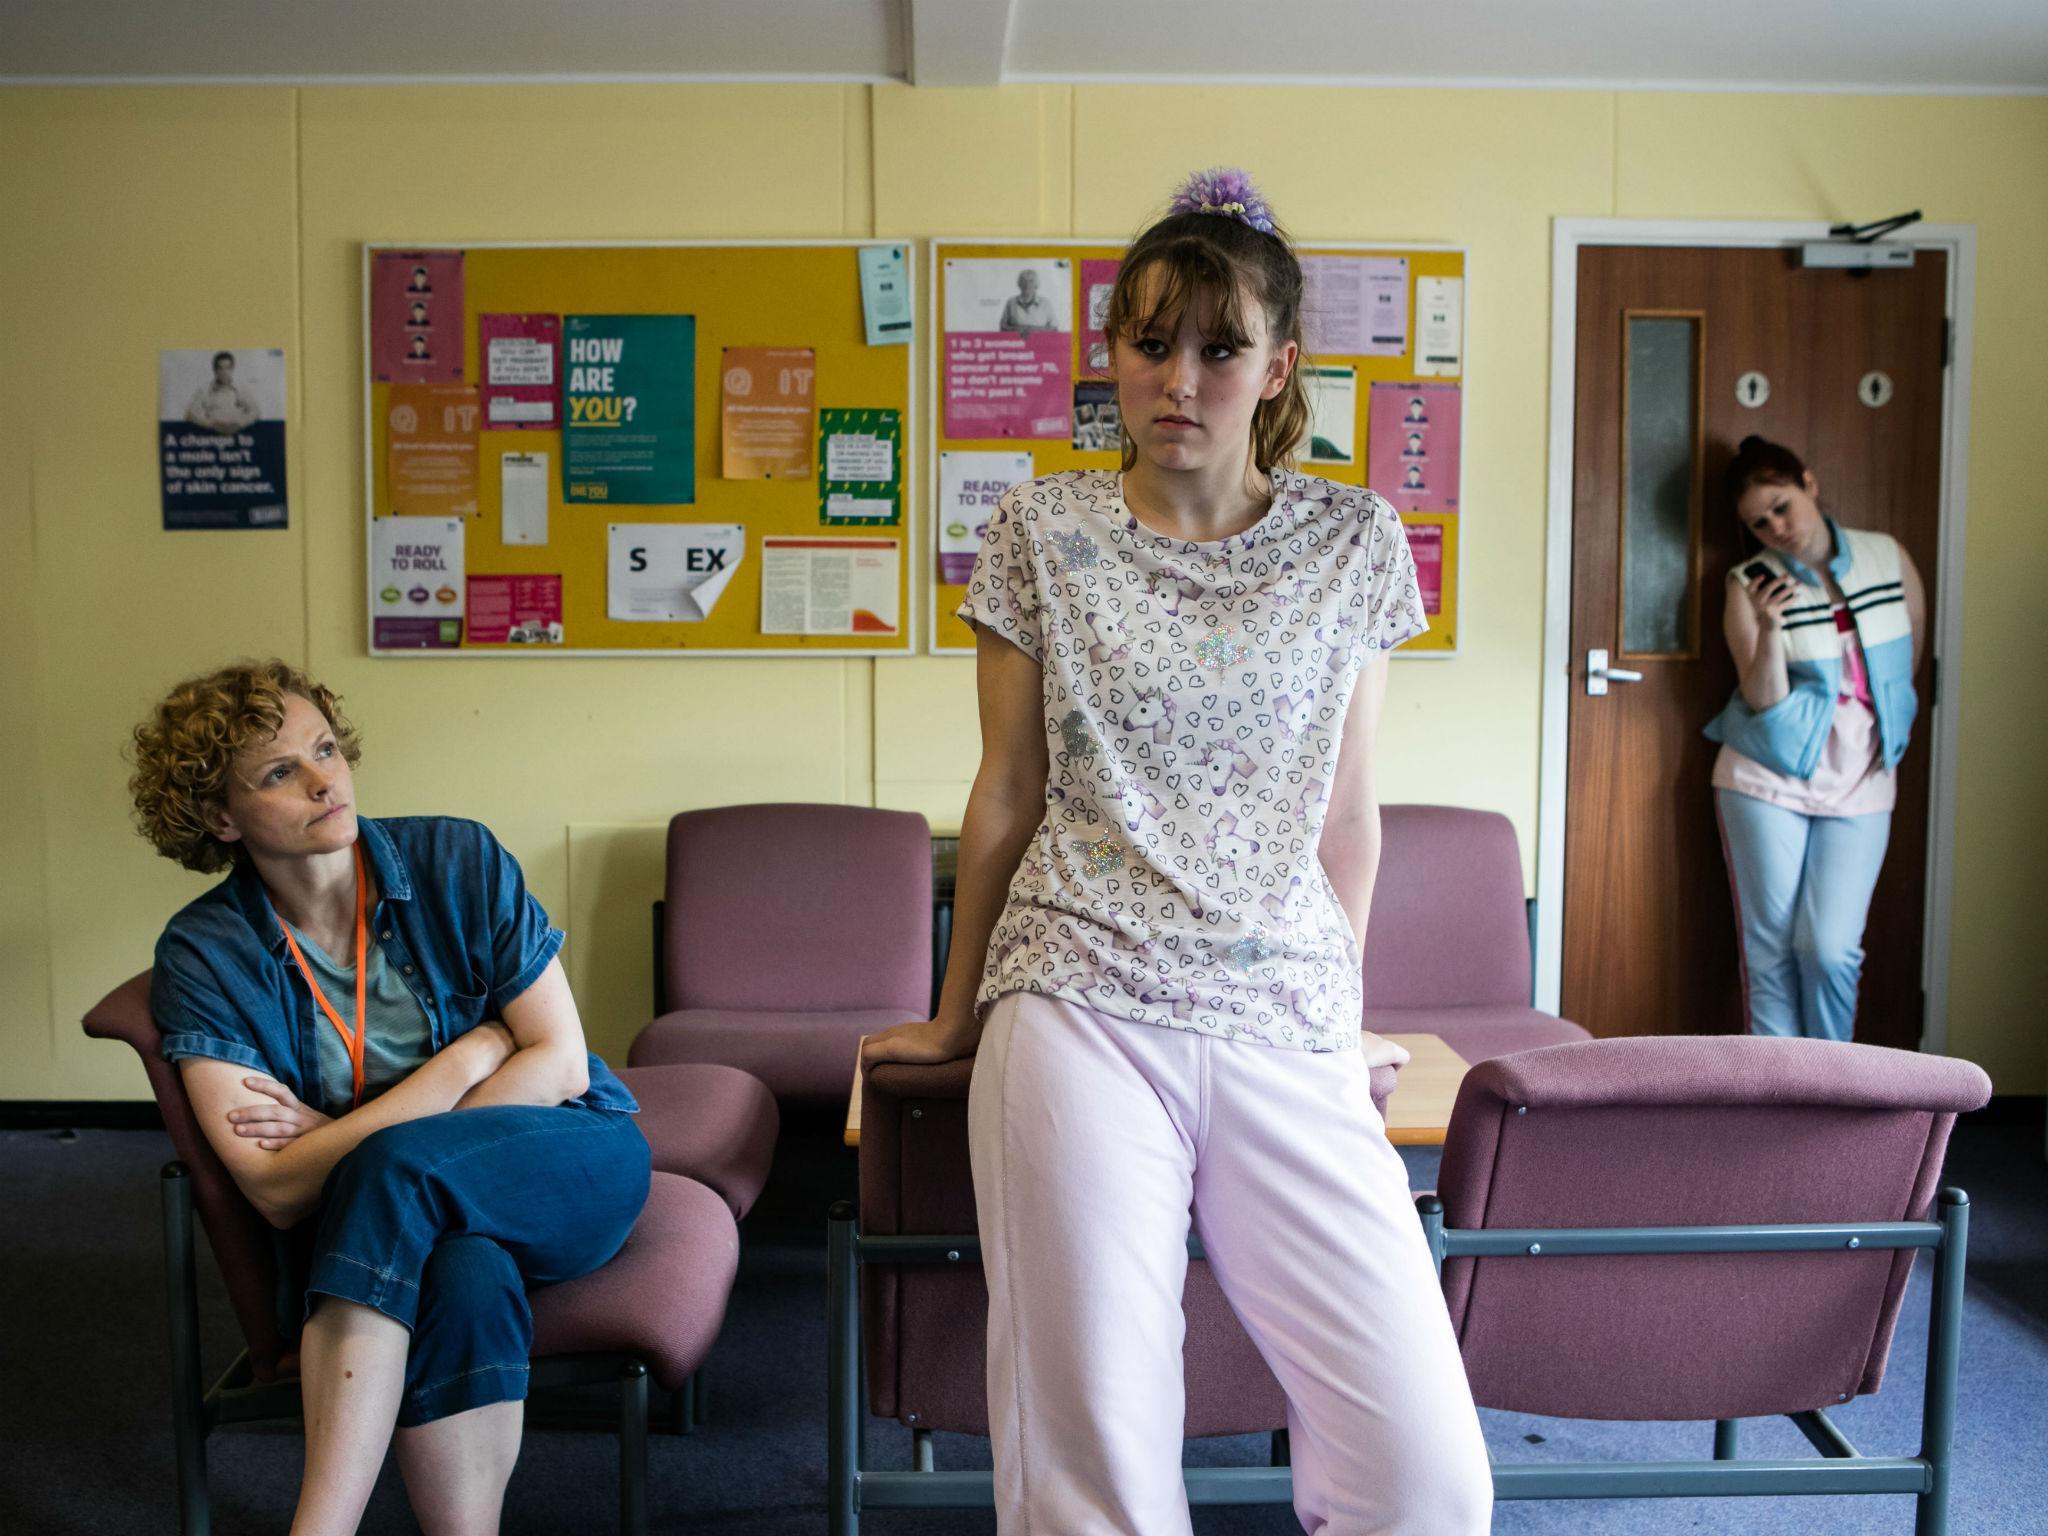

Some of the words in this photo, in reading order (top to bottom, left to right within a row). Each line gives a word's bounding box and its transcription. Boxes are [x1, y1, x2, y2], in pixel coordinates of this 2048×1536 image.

[569, 338, 623, 363] HOW
[984, 340, 1025, 348] women
[951, 351, 975, 360] who
[977, 351, 996, 362] get
[998, 351, 1034, 360] breast
[951, 364, 990, 373] cancer
[992, 364, 1012, 373] are
[1014, 364, 1039, 373] over
[569, 367, 615, 392] ARE
[780, 368, 814, 395] IT
[951, 376, 965, 385] so
[967, 375, 997, 385] don't
[1000, 377, 1043, 385] assume
[951, 387, 986, 399] you're
[988, 388, 1013, 399] past
[569, 396, 637, 421] YOU?
[444, 405, 478, 432] IT
[165, 434, 177, 447] A
[180, 434, 235, 450] change
[238, 434, 254, 447] to
[166, 452, 176, 463] a
[180, 451, 216, 463] mole
[220, 450, 251, 463] isn't
[166, 466, 191, 478] the
[194, 465, 226, 480] only
[229, 466, 261, 480] sign
[167, 481, 182, 494] of
[185, 481, 217, 494] skin
[220, 482, 275, 494] cancer.
[963, 480, 1010, 492] READY
[958, 494, 976, 506] TO
[981, 494, 1000, 506] RO
[395, 545, 442, 557] READY
[391, 559, 409, 571] TO
[413, 559, 447, 571] ROLL
[630, 547, 648, 572] S
[686, 548, 726, 572] EX
